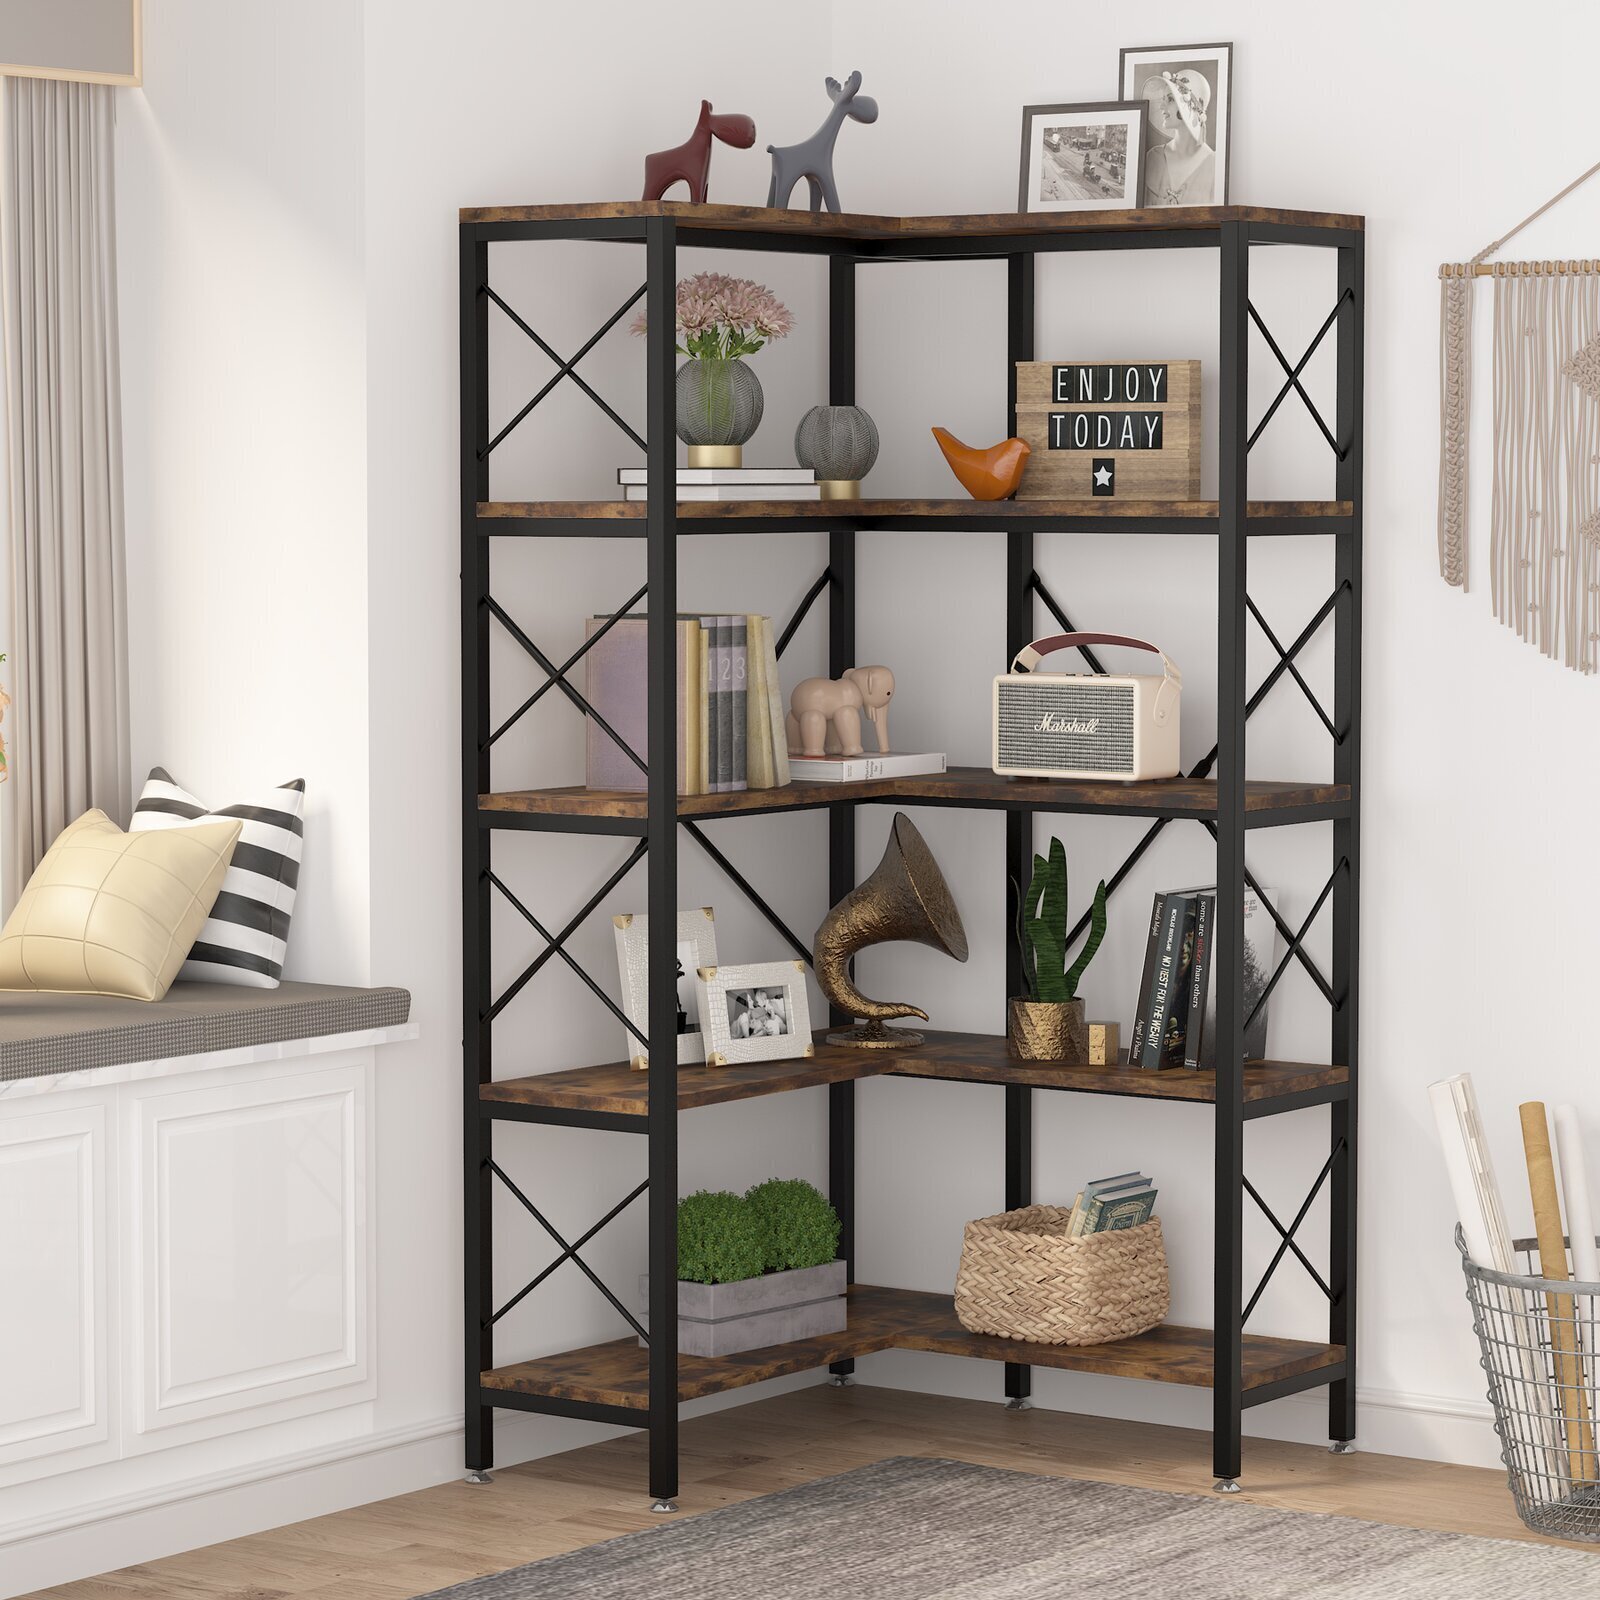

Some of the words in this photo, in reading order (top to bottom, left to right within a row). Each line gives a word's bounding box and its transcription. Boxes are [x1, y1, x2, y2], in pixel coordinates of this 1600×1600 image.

[1056, 366, 1164, 402] ENJOY
[1051, 413, 1160, 448] TODAY
[721, 657, 731, 680] 2
[735, 656, 746, 680] 3
[1033, 711, 1100, 734] Marshall
[1199, 900, 1207, 923] some
[1162, 955, 1172, 967] NO
[1159, 968, 1169, 988] REST
[1194, 964, 1203, 982] than
[1156, 988, 1167, 1003] FOR
[1192, 983, 1201, 1009] others
[1154, 1004, 1164, 1019] THE
[1148, 1019, 1161, 1049] WEARY
